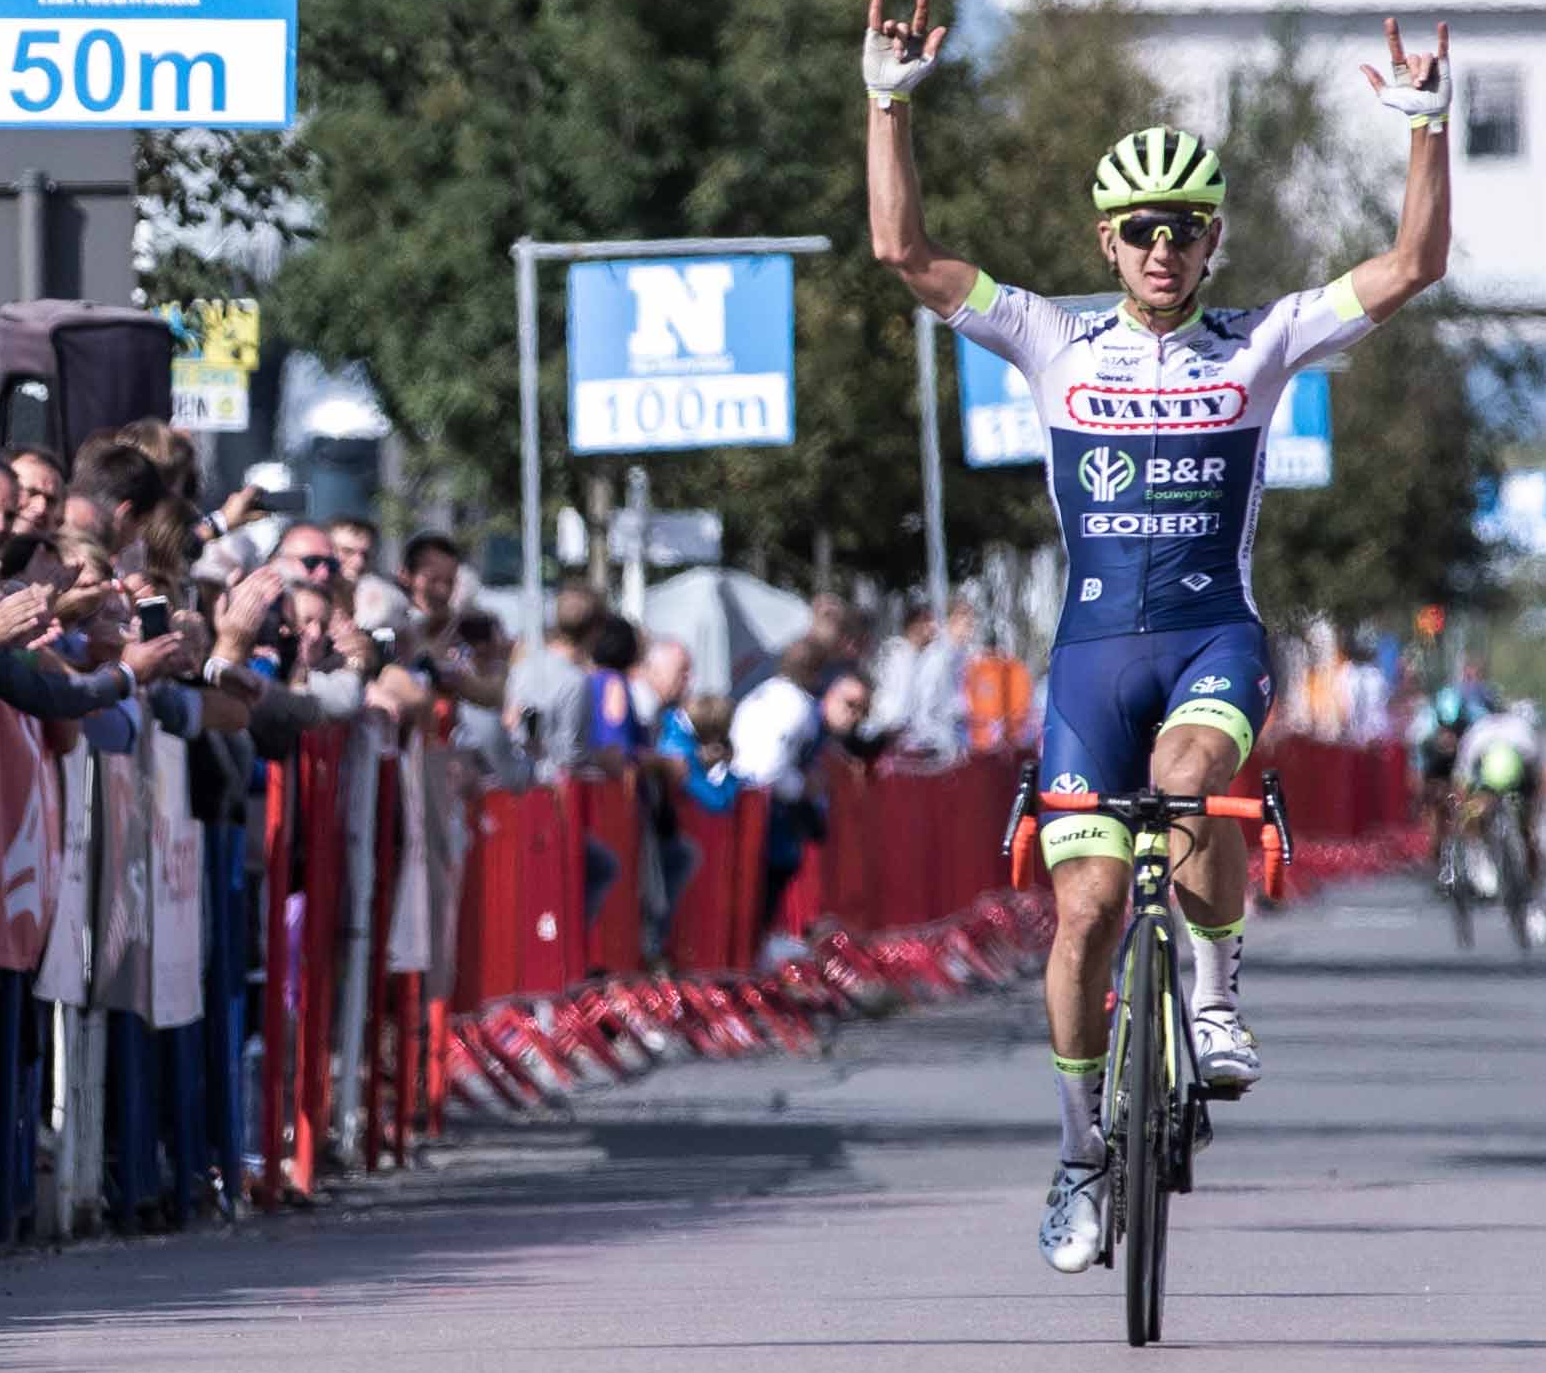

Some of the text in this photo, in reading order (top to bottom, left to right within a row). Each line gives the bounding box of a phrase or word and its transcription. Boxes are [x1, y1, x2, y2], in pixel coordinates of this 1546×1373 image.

[10, 28, 228, 113] 50m
[627, 263, 735, 356] N
[605, 383, 770, 433] 100m
[1088, 396, 1225, 418] WANTY
[1145, 457, 1227, 484] B&R
[1144, 489, 1223, 502] Bouwgroep
[1086, 515, 1214, 535] GOBERT
